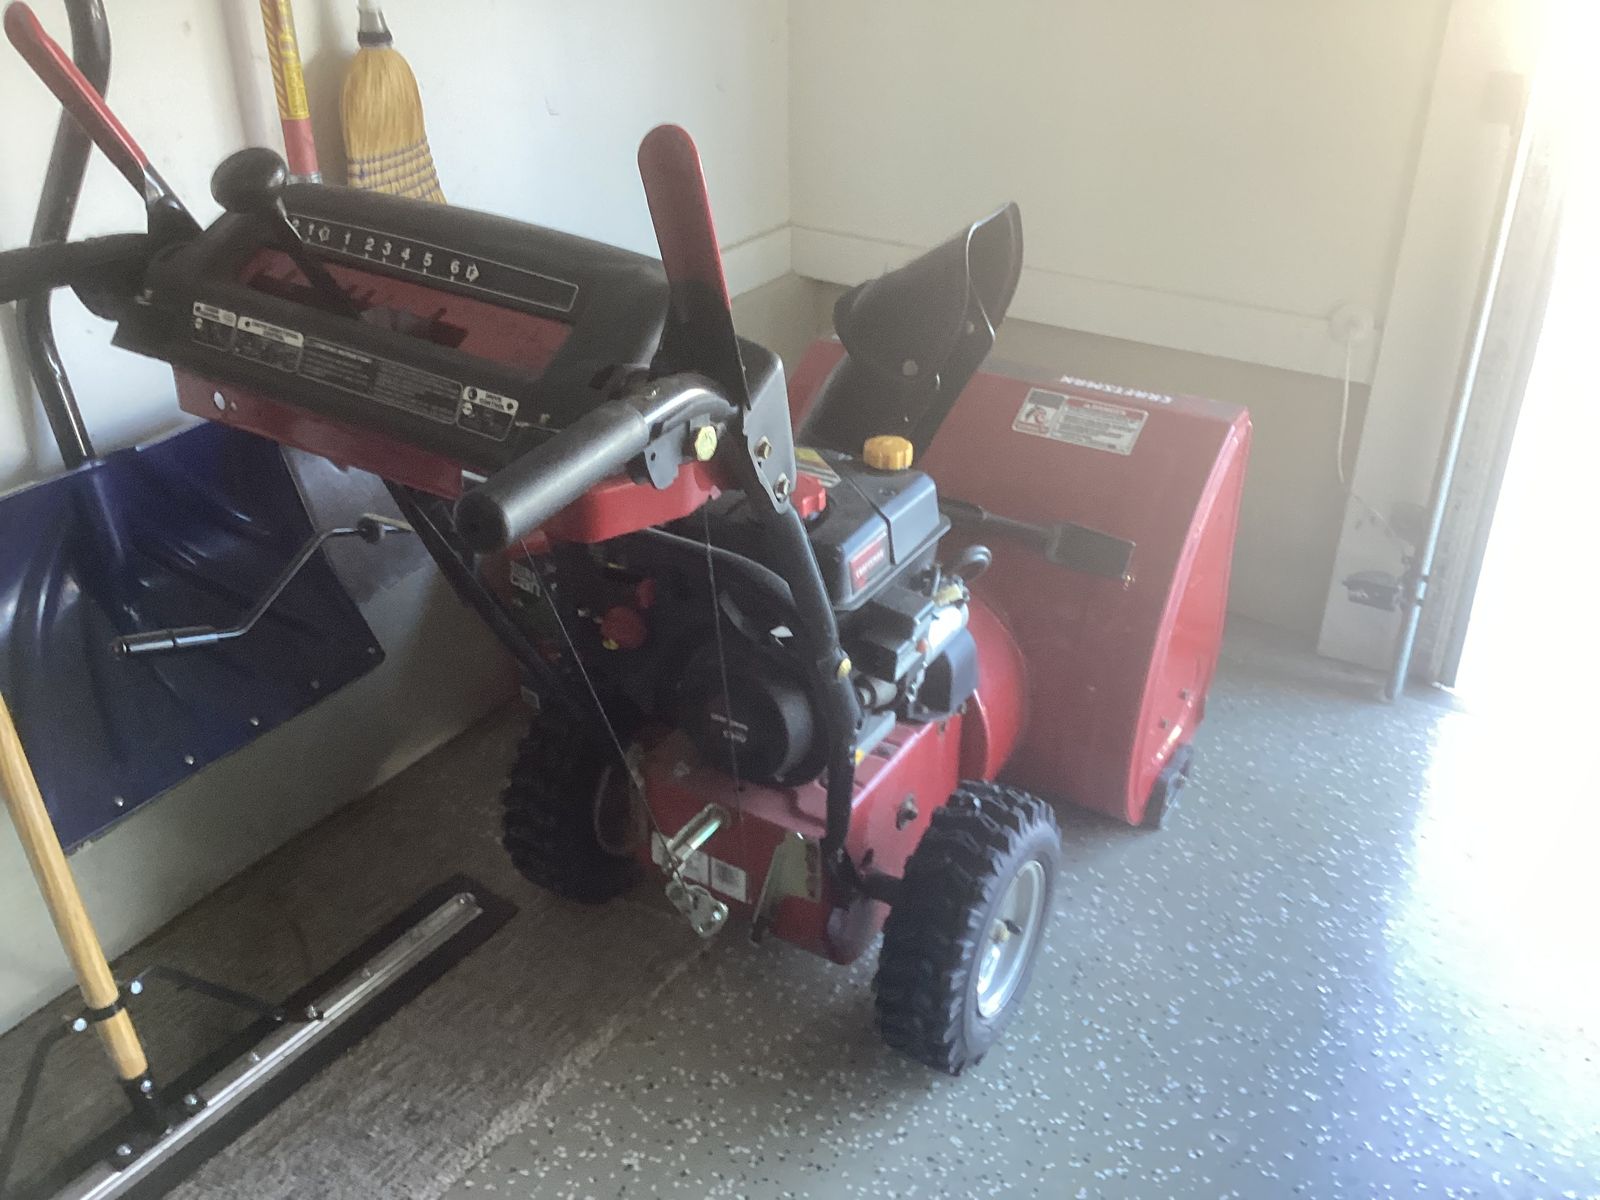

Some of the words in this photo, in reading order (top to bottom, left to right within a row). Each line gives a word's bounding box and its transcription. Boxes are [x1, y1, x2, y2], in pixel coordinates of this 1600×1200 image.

[345, 232, 351, 245] 1
[365, 237, 375, 252] 2
[382, 241, 392, 256] 3
[401, 247, 410, 261] 4
[423, 252, 433, 267] 5
[450, 260, 460, 275] 6
